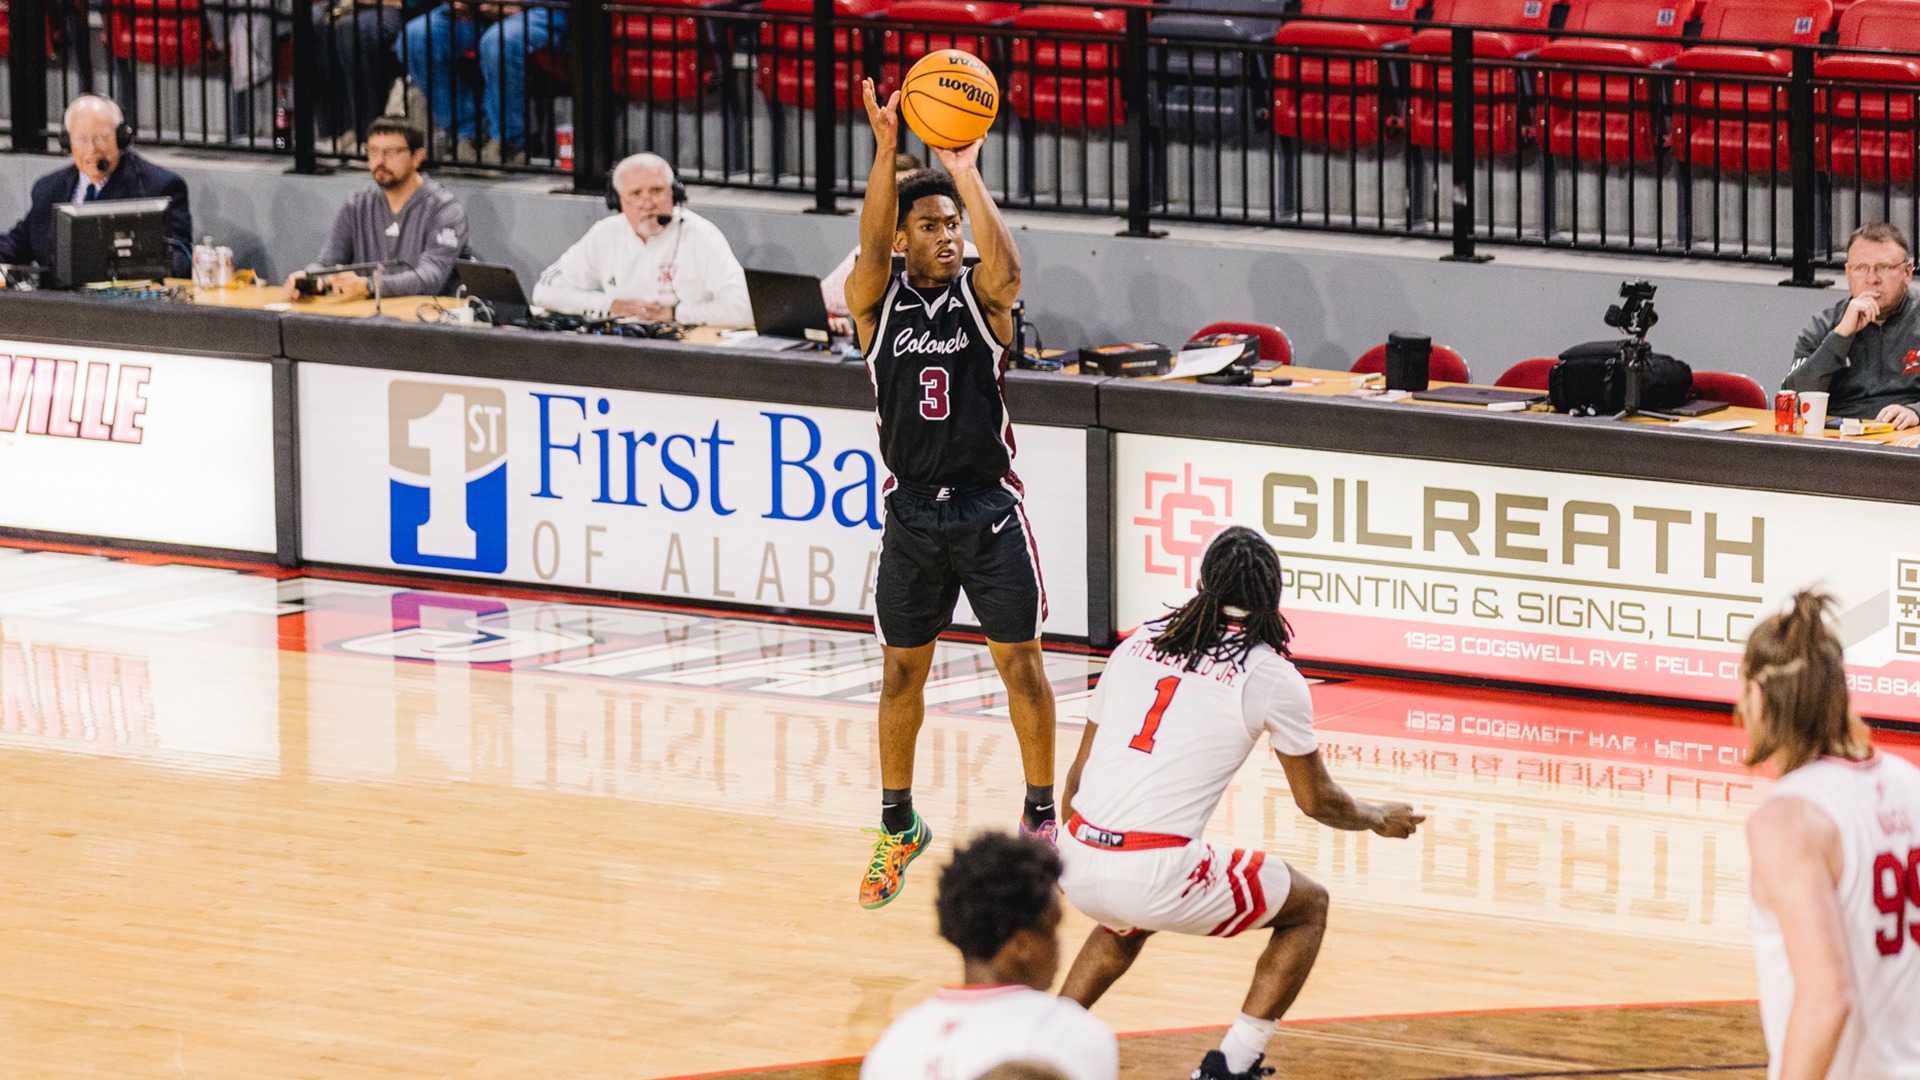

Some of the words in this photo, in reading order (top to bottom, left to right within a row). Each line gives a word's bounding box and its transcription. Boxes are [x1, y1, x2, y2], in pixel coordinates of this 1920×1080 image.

[938, 77, 994, 111] Wilson
[893, 327, 970, 357] Colonels
[919, 366, 950, 421] 3
[529, 391, 737, 517] First
[760, 411, 884, 530] Ba
[532, 520, 608, 584] OF
[1262, 472, 1766, 584] GILREATH
[1472, 587, 1504, 619] &
[1517, 591, 1654, 641] SIGNS,
[1667, 605, 1755, 645] LLC
[1403, 631, 1455, 653] 1923
[1461, 636, 1585, 666] COGSWELL
[1589, 650, 1637, 670] AVE
[1655, 656, 1713, 678] PELL
[1718, 661, 1739, 680] CI
[1128, 675, 1182, 755] 1
